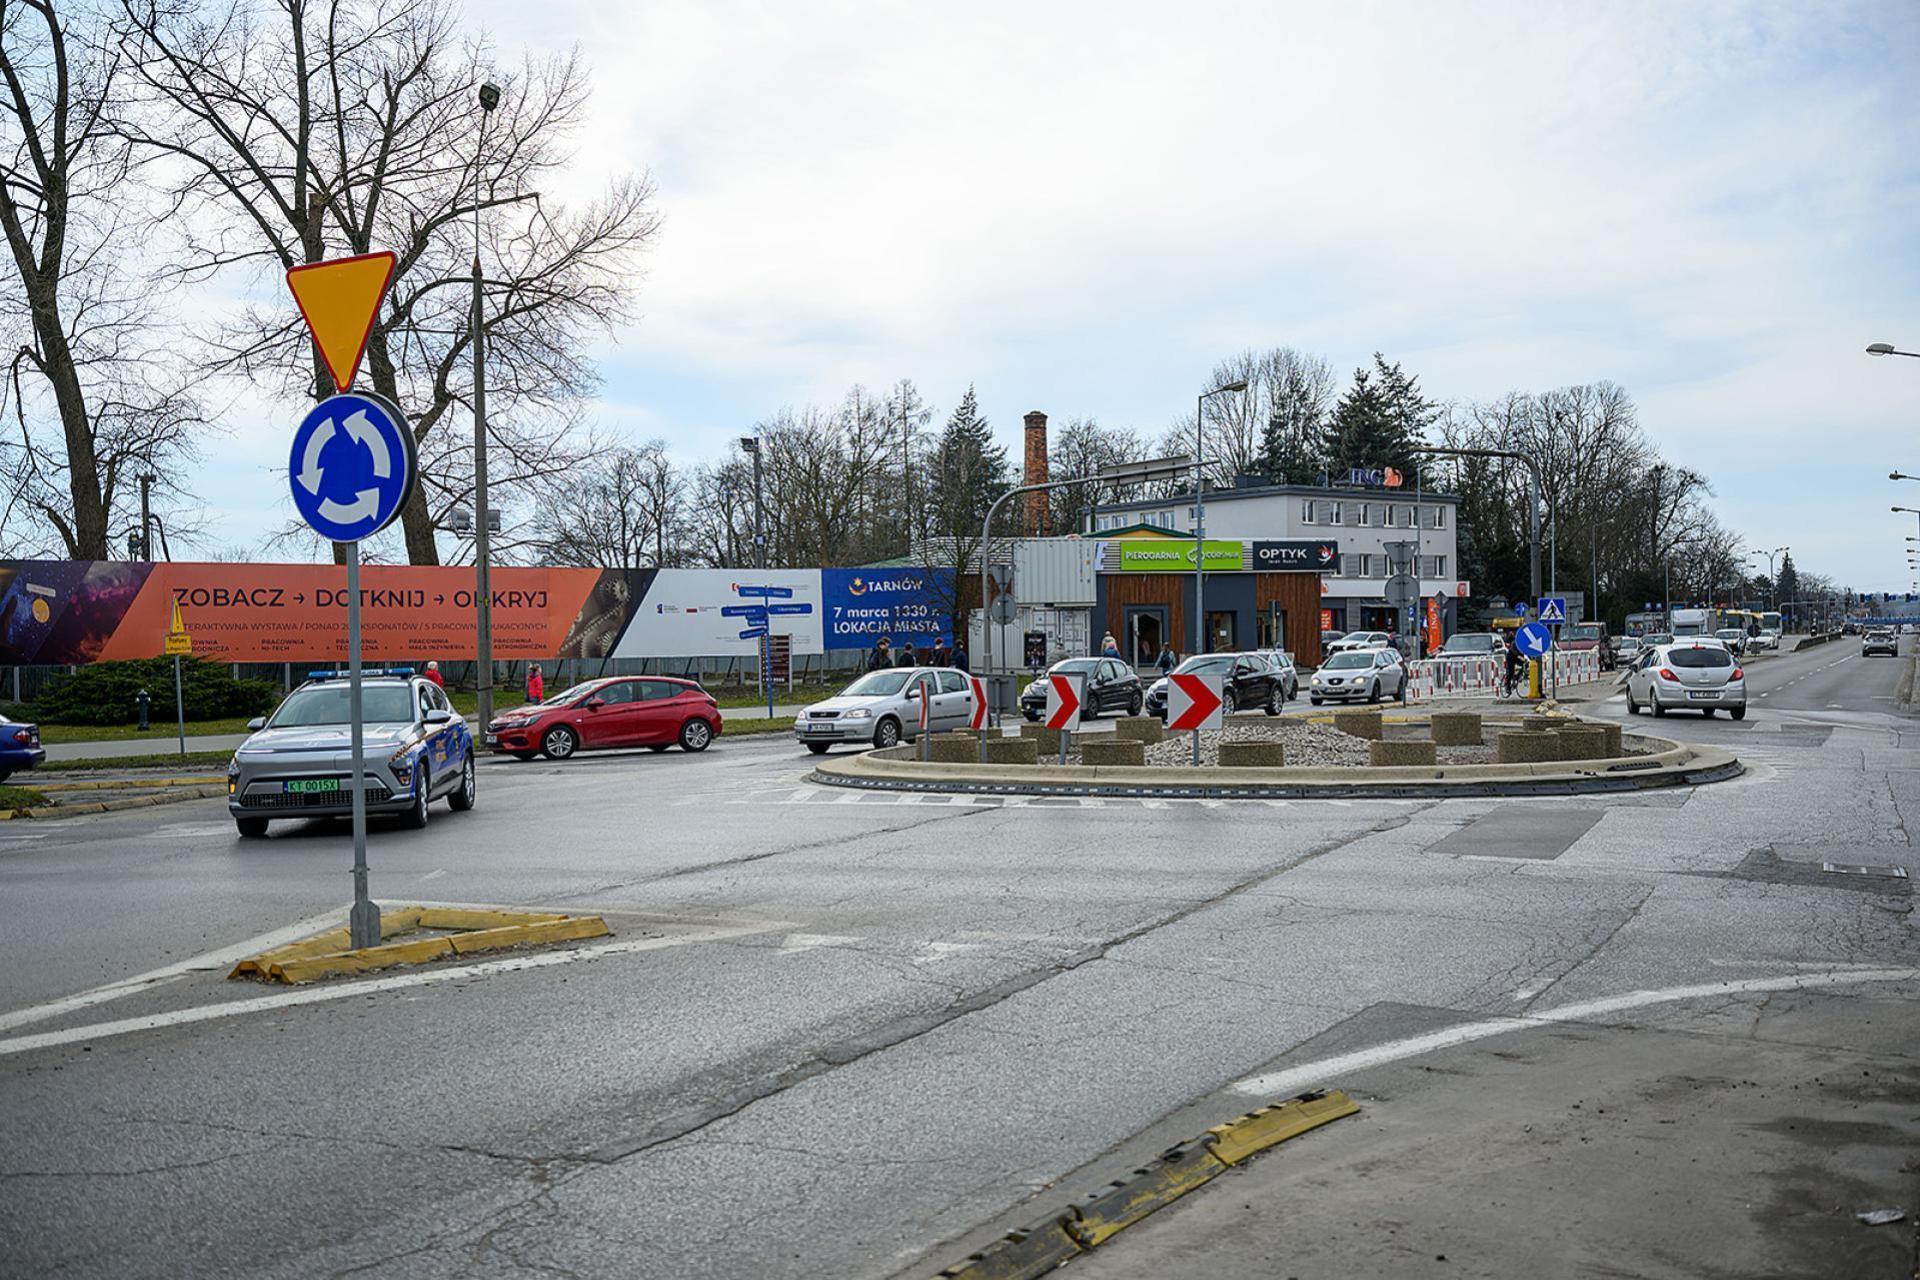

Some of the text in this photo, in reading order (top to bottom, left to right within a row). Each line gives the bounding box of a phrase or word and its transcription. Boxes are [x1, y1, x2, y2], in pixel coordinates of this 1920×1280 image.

[1351, 468, 1382, 486] ING
[1125, 551, 1181, 561] PIEROGARNIA
[1259, 548, 1307, 559] OPTYK
[868, 577, 923, 592] TARNÓW
[173, 588, 548, 608] ZOBACZ DOTKNIJ OKRYJ
[833, 606, 843, 619] 7
[847, 606, 889, 618] marca
[894, 604, 928, 617] 1330
[184, 622, 248, 631] TERAKTYWNA
[250, 622, 298, 631] WYSTAWA
[305, 622, 340, 631] PONAD
[360, 621, 418, 631] KSPONATÓW
[432, 623, 477, 631] PRACOWN
[833, 620, 941, 634] LOKACJA MIASTA
[305, 780, 336, 791] 0015X
